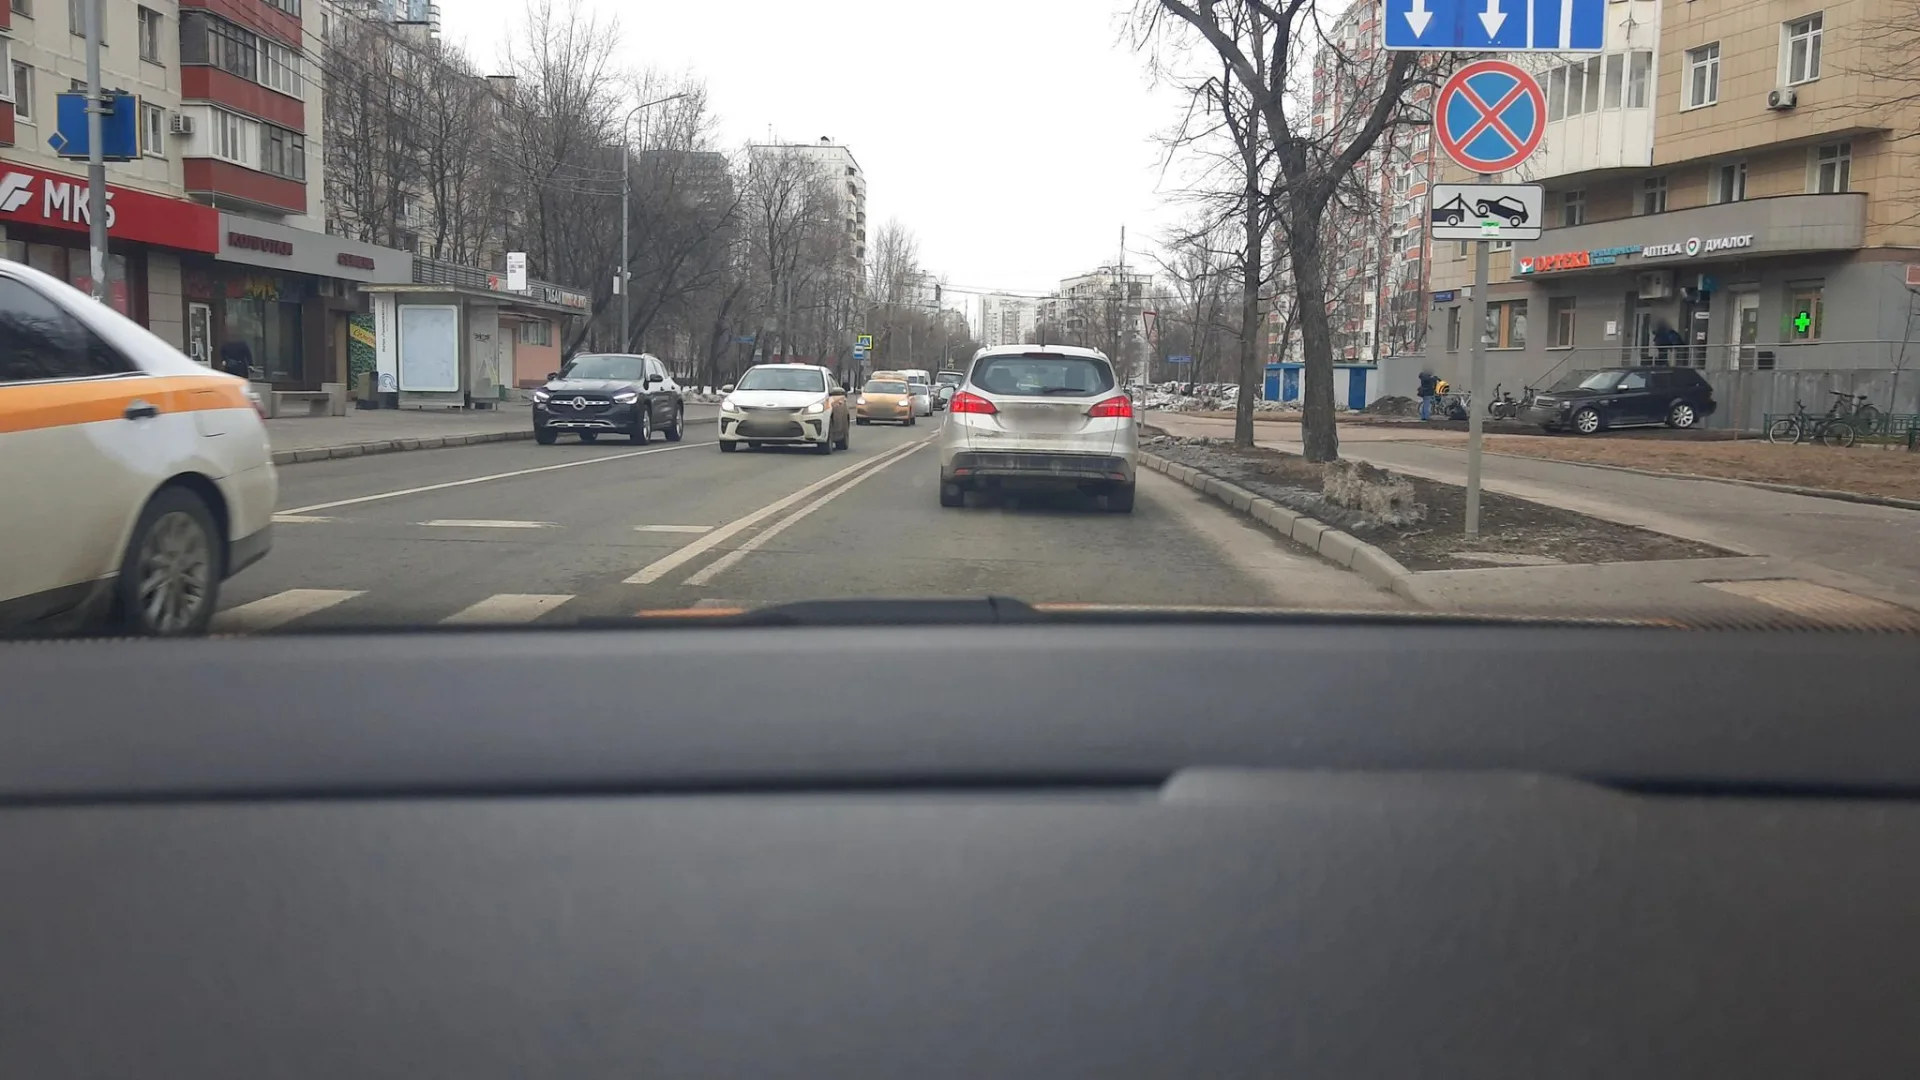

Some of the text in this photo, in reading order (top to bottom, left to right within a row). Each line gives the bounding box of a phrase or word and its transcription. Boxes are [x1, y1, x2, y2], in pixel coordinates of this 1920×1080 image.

[43, 178, 116, 228] МКБ
[1642, 243, 1682, 257] АПТЕКА
[1704, 234, 1754, 252] ДИАЛОГ
[1534, 250, 1591, 272] ОРТЕКА
